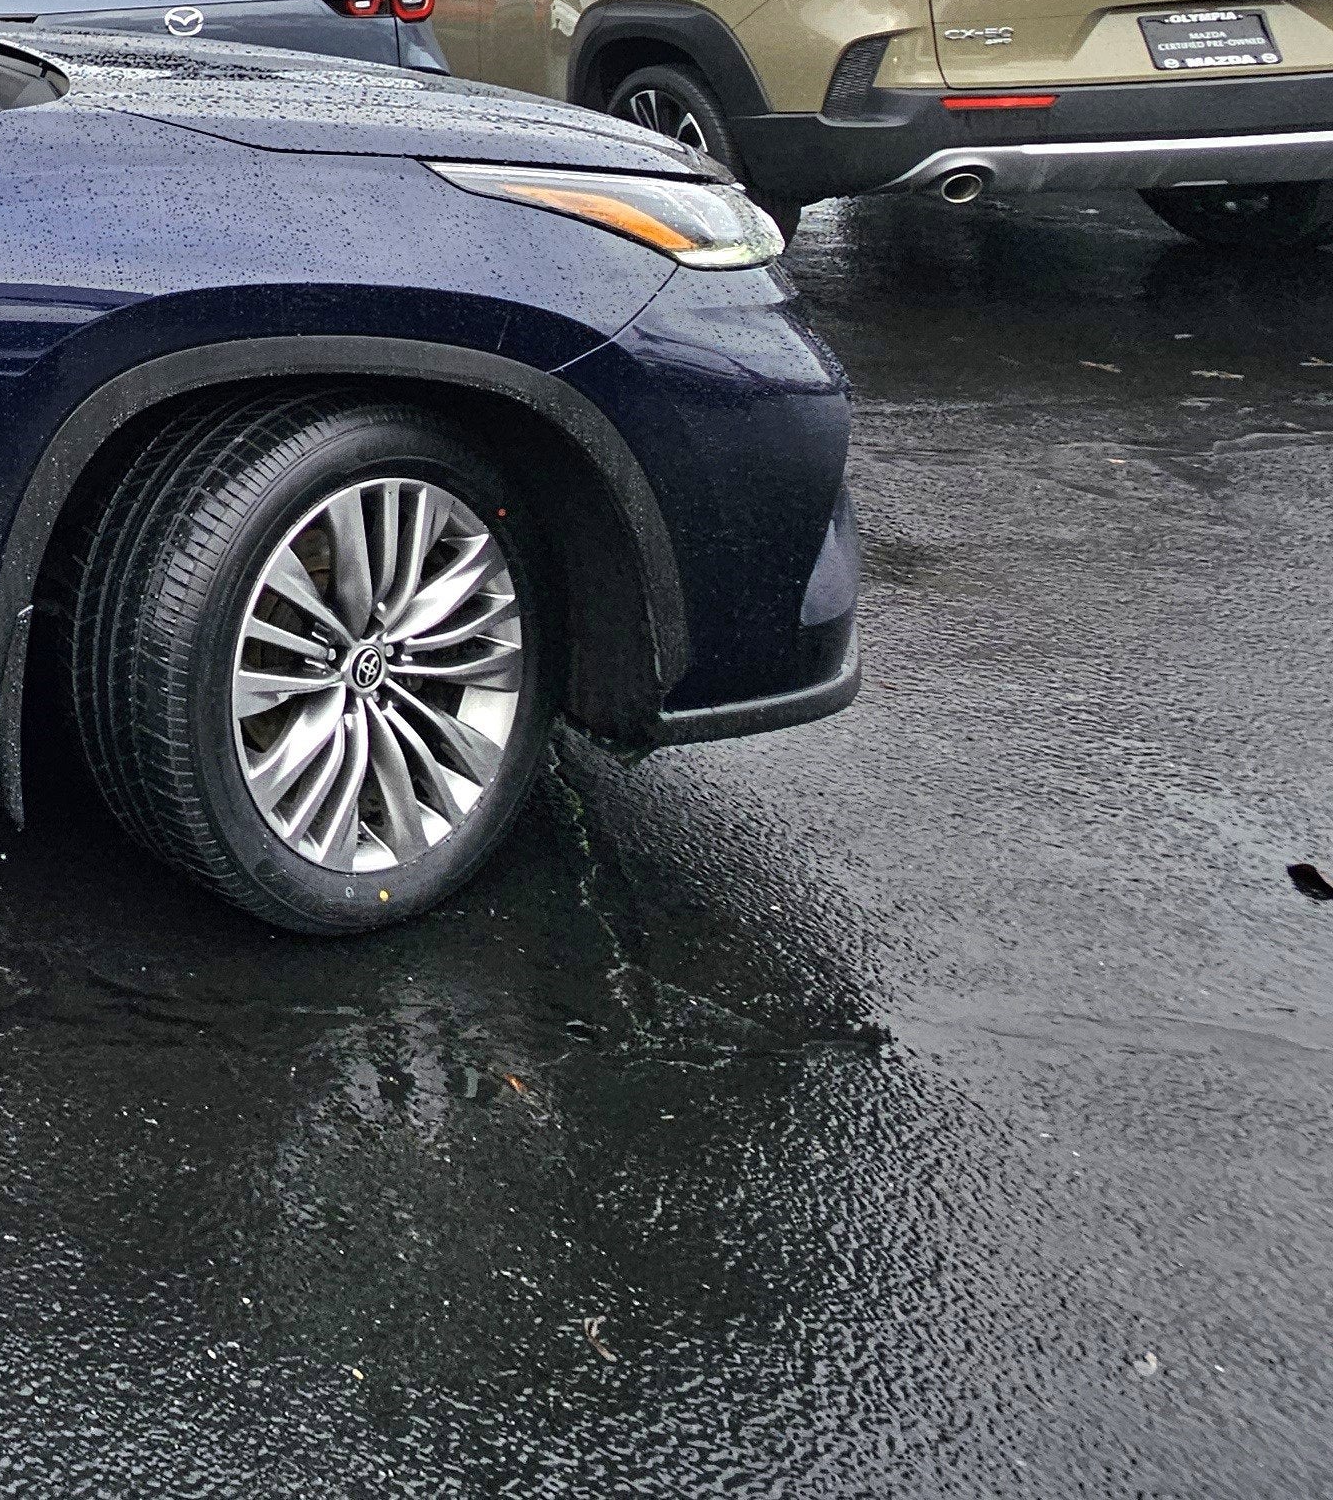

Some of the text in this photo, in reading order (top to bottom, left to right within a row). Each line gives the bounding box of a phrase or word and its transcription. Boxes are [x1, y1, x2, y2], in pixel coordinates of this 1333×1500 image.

[1168, 11, 1238, 23] OLYMPIA
[1188, 31, 1227, 40] MAZDA
[1157, 37, 1266, 51] CERTIFIED PRE-OWNED
[1185, 54, 1257, 67] MAZDA
